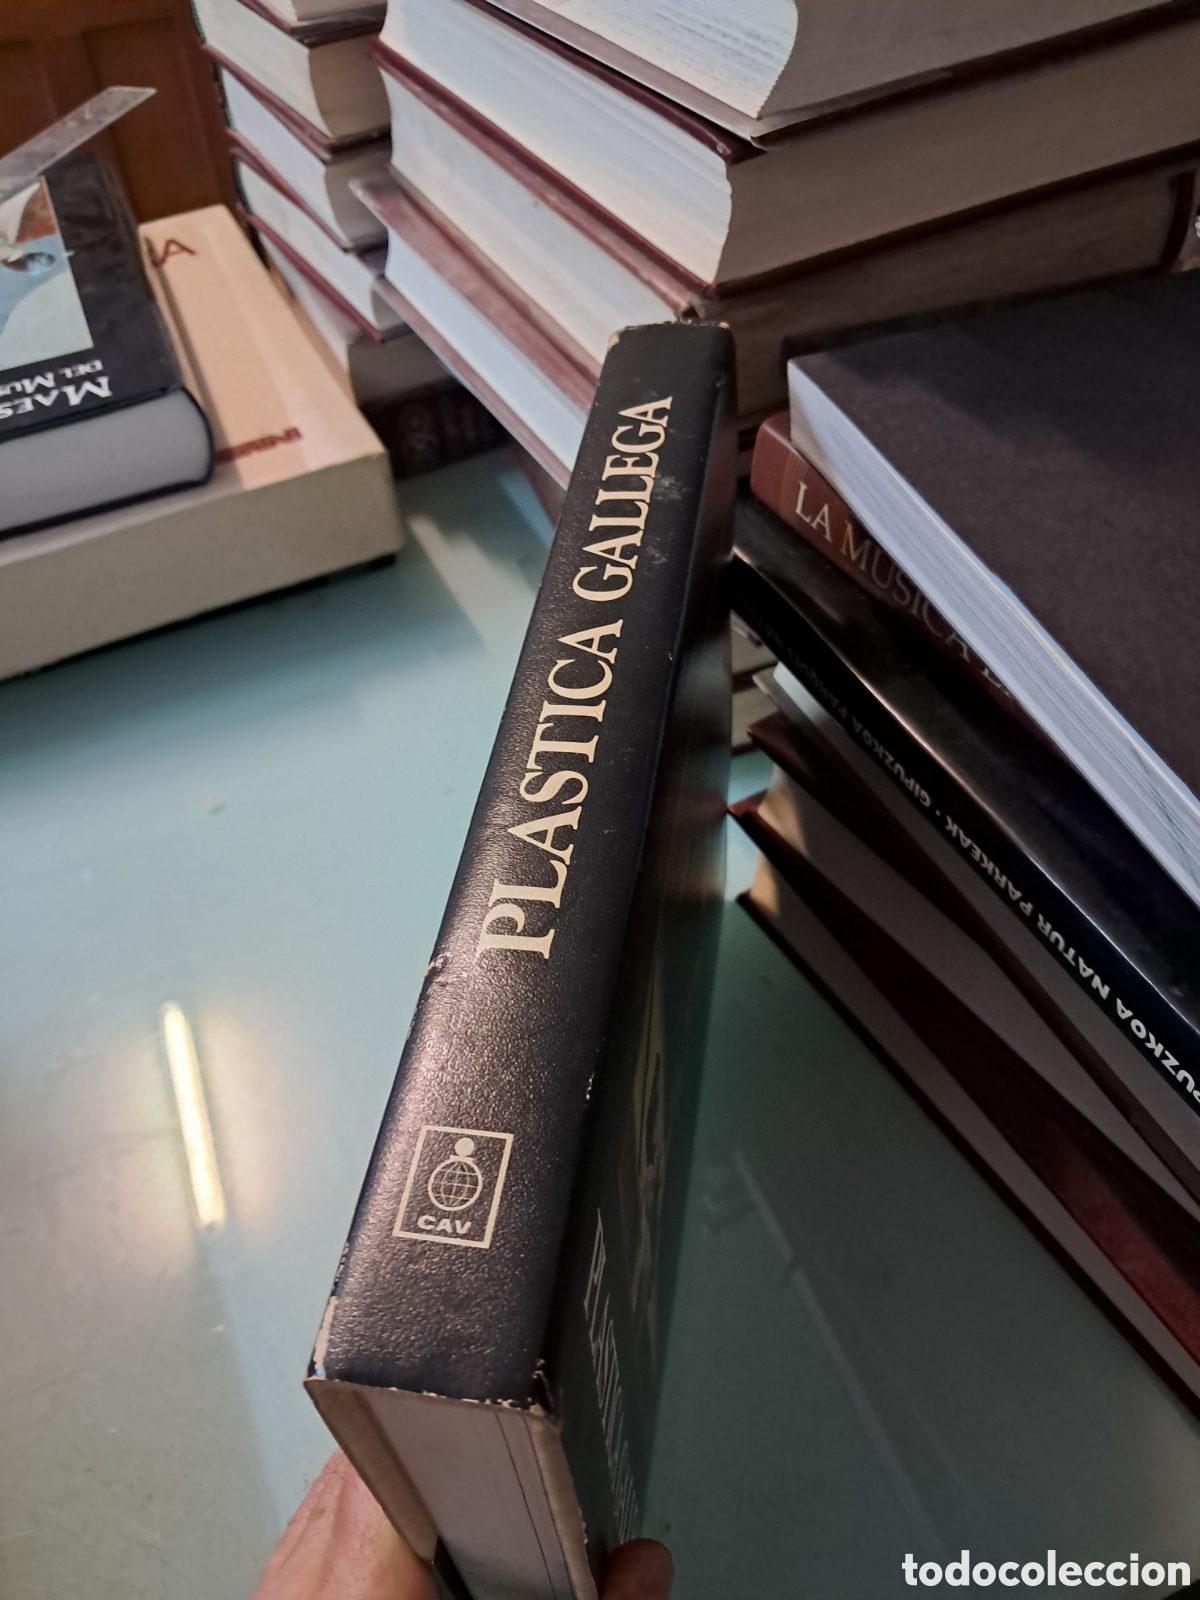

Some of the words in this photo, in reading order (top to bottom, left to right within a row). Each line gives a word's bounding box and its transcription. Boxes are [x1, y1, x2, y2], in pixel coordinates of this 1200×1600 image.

[60, 359, 103, 379] DEL
[794, 480, 833, 543] LA
[475, 619, 623, 960] PLASTICA
[572, 396, 673, 602] GALLEGA
[851, 715, 931, 808] GIPUZKOA
[944, 815, 1033, 917] PARKEAK
[1037, 912, 1110, 1000] NATUR
[417, 1215, 472, 1234] CAV
